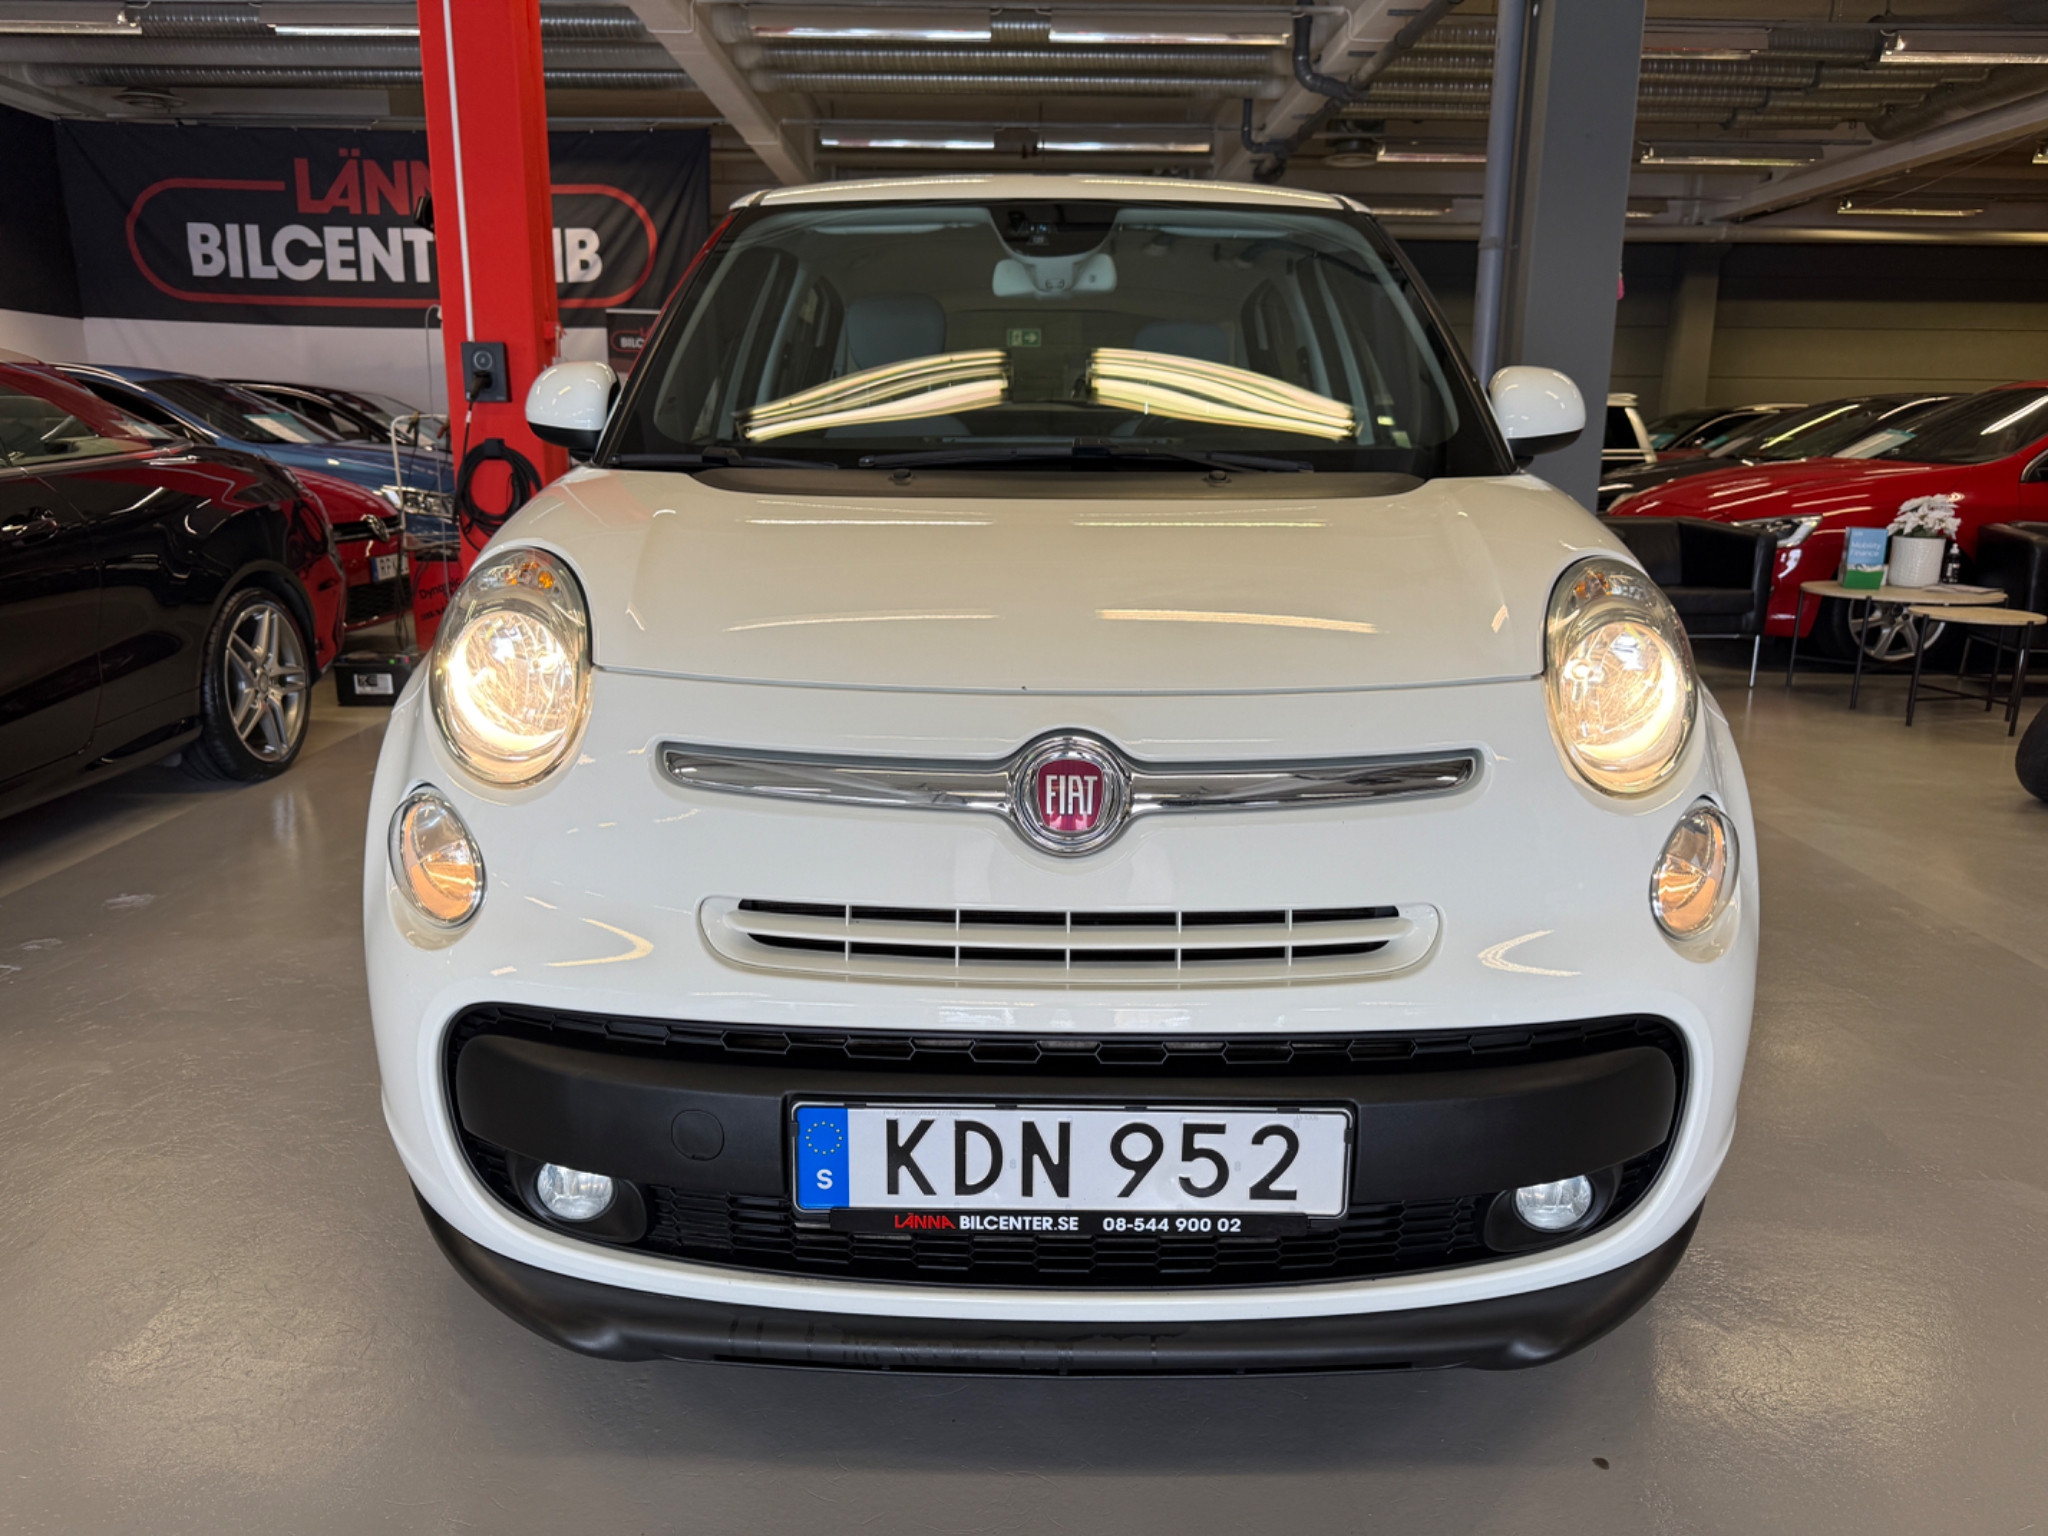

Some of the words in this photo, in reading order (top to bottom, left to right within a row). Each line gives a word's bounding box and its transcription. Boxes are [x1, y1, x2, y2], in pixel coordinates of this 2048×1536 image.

[186, 222, 436, 283] BILCENT
[1045, 774, 1098, 815] FIAT
[815, 1168, 834, 1190] S
[886, 1118, 1071, 1198] KDN
[1110, 1123, 1300, 1201] 952
[894, 1212, 956, 1230] LÄNNA
[959, 1215, 1079, 1231] BILCENTER.SE
[1102, 1217, 1170, 1232] 08-544
[1175, 1217, 1212, 1232] 900
[1217, 1217, 1242, 1232] 02
